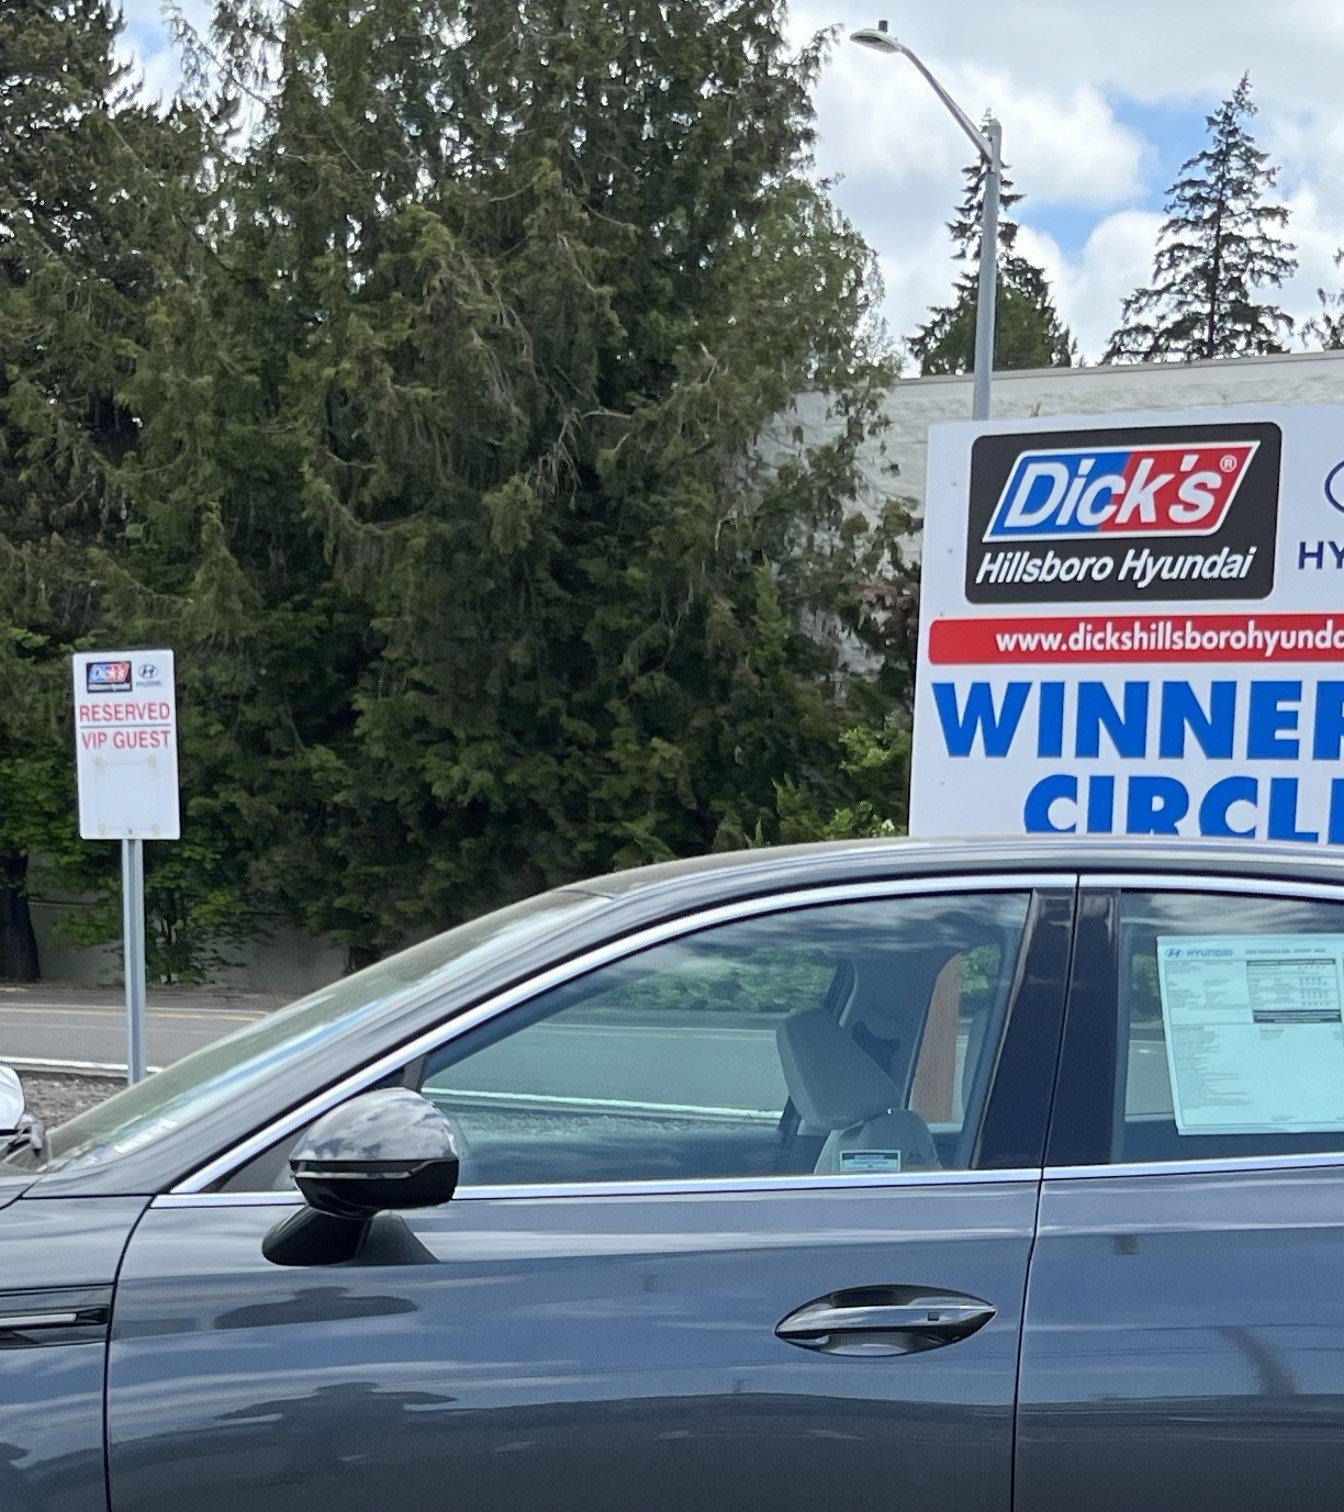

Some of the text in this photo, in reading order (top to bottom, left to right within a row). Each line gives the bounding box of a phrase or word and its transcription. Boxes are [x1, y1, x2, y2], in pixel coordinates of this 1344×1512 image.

[1003, 454, 1223, 528] Dick's
[975, 545, 1258, 589] Hillsboro Hyundai
[79, 702, 170, 722] RESERVED
[81, 730, 171, 749] VIP GUEST
